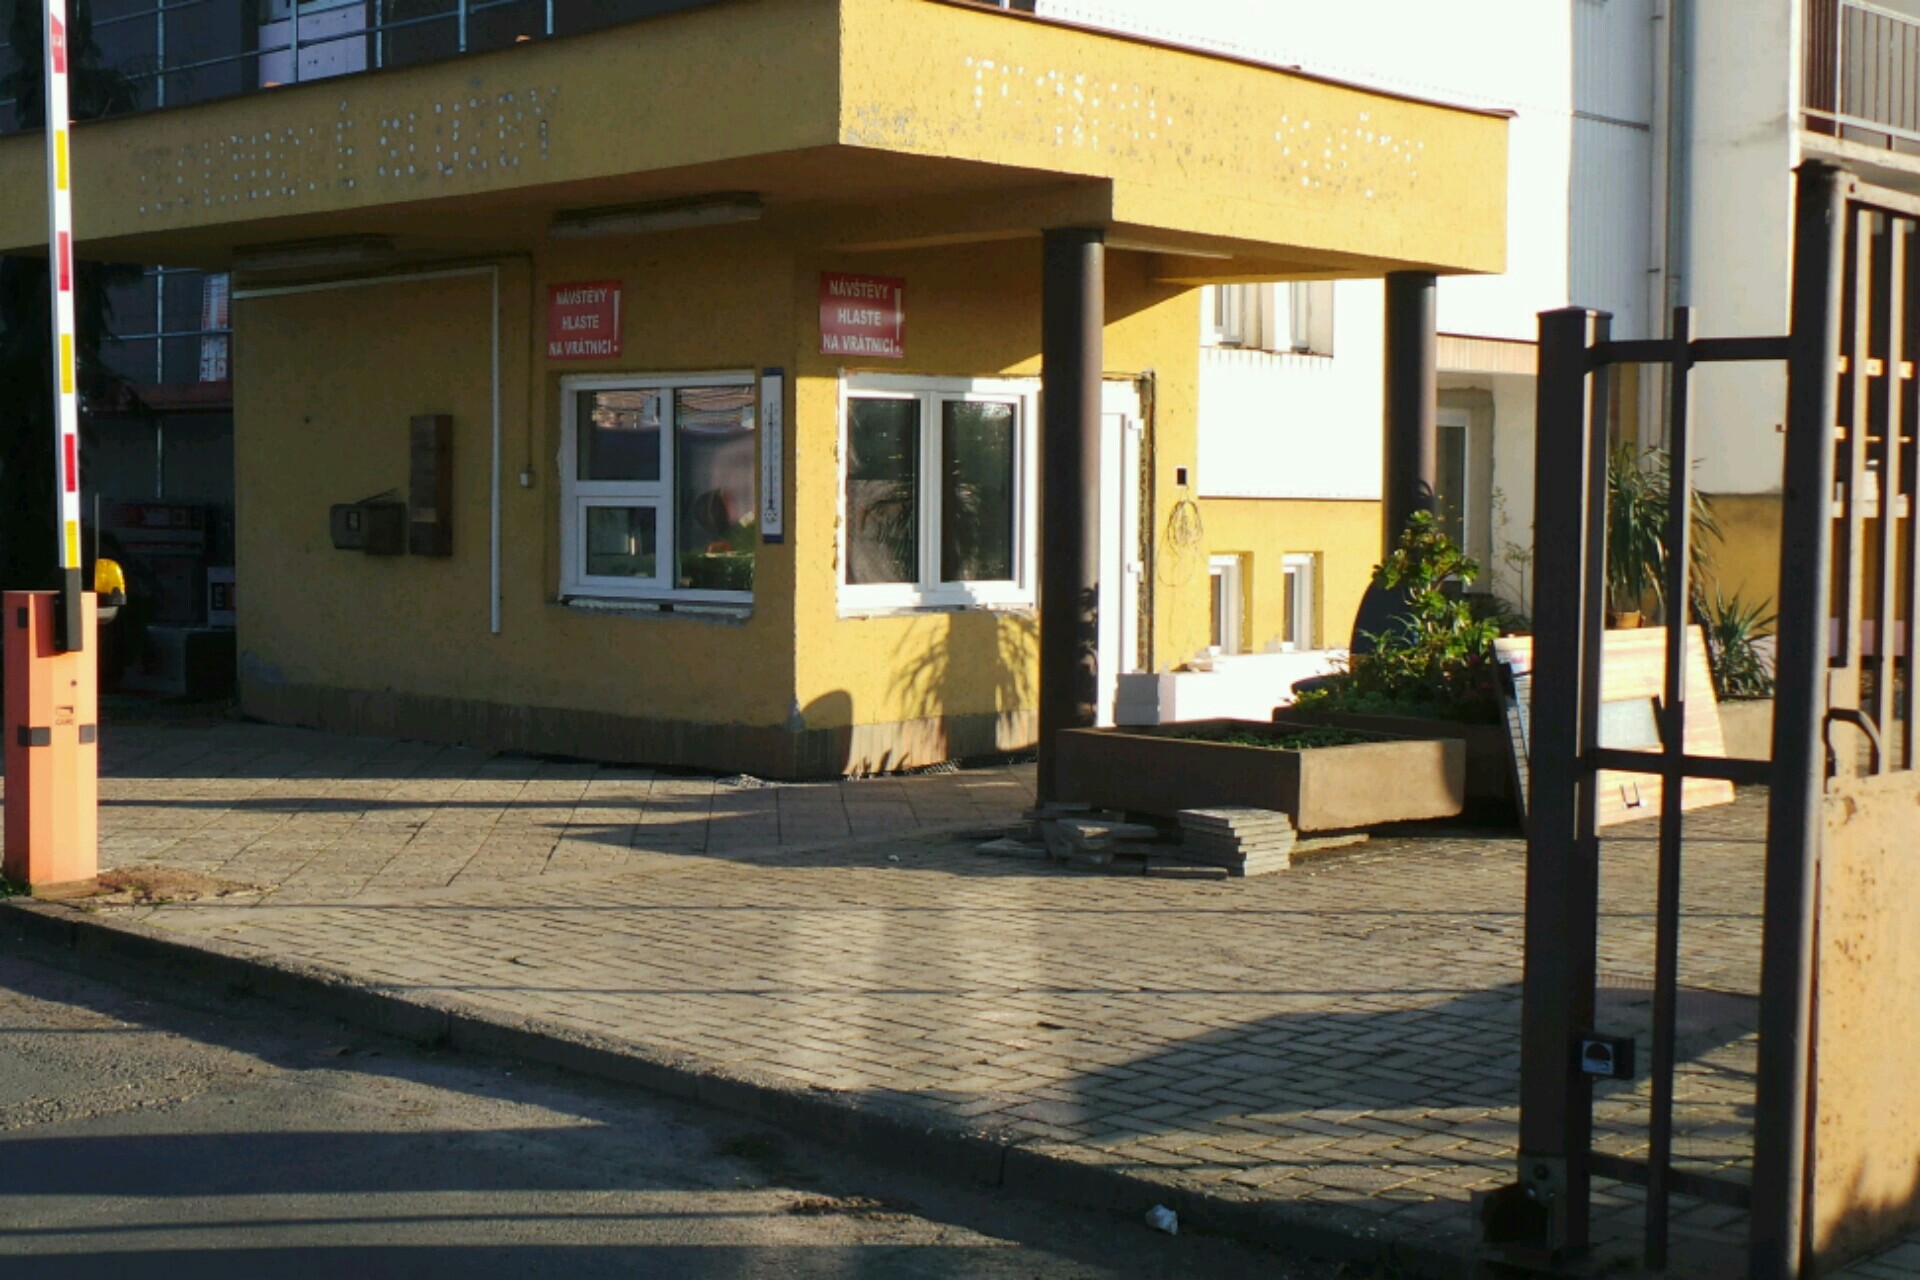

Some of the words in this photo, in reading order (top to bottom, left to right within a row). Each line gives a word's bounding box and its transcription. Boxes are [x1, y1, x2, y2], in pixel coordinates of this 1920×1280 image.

[829, 278, 889, 299] NÁVŠTĚVY
[561, 314, 600, 331] HLASTE
[838, 308, 882, 326] HLASTE
[548, 340, 563, 356] NA
[563, 337, 611, 356] VRÁTNICI
[823, 333, 839, 351] NA
[841, 333, 893, 353] VRÁTNICI
